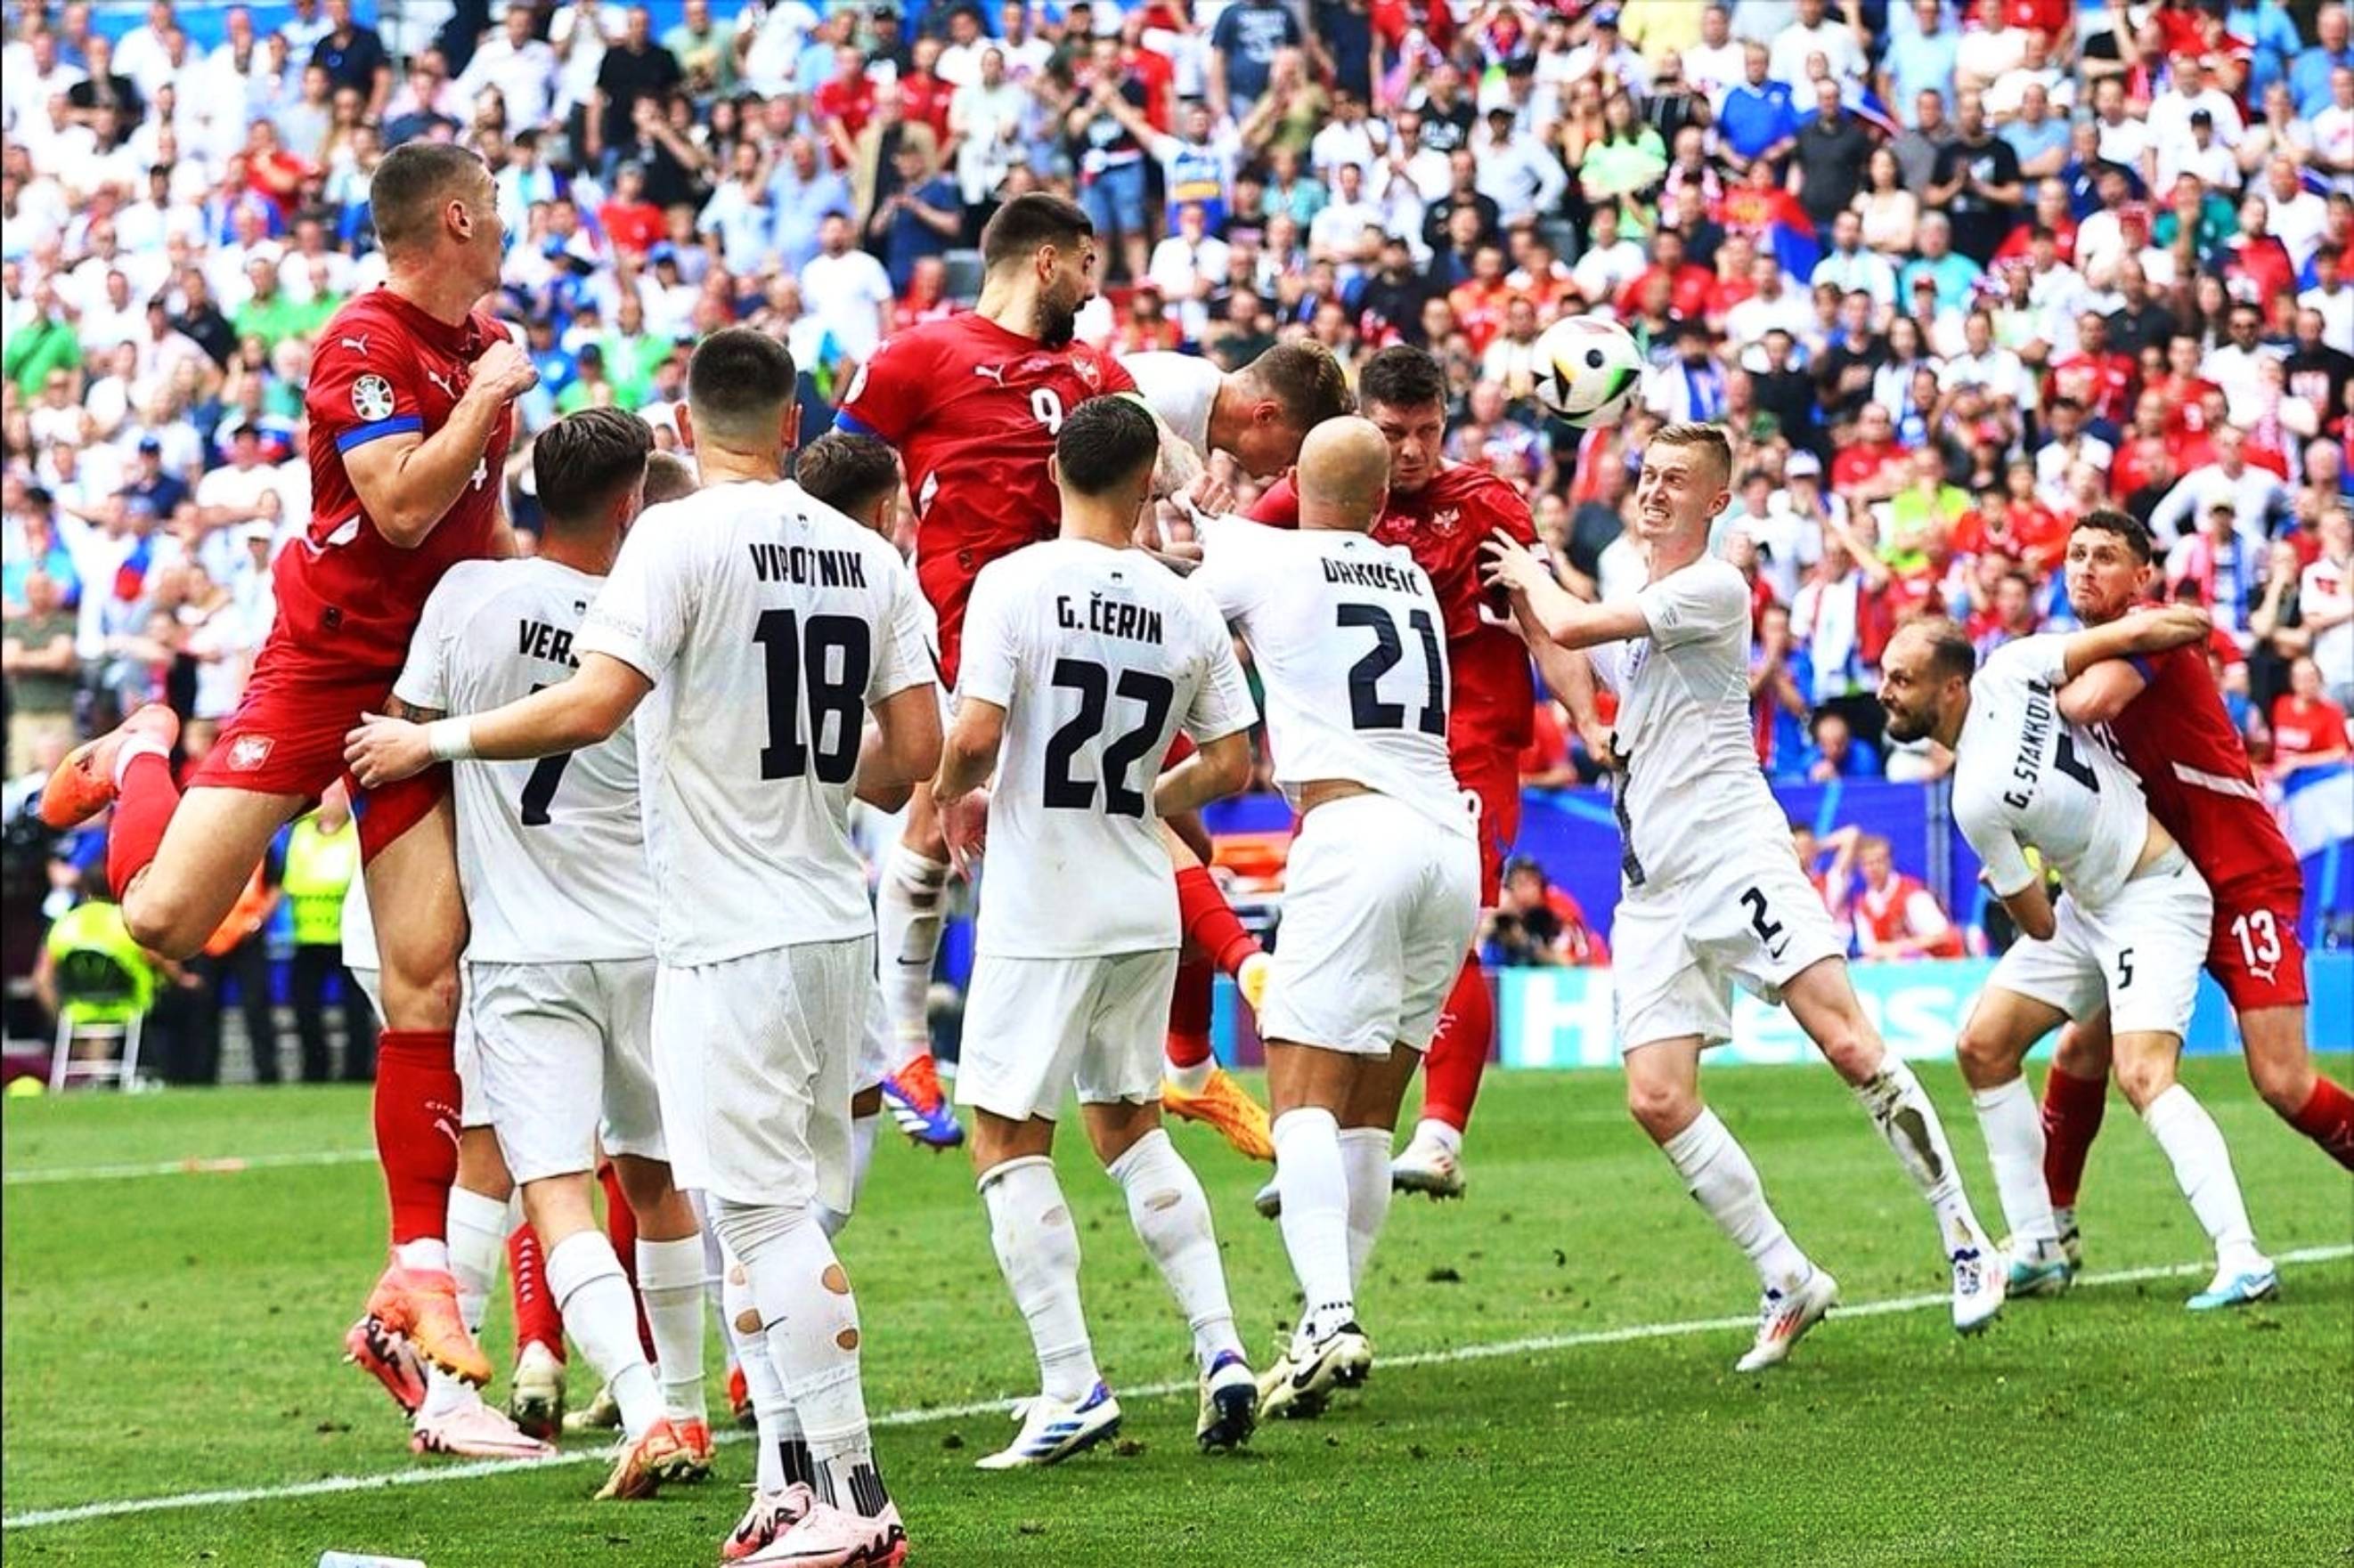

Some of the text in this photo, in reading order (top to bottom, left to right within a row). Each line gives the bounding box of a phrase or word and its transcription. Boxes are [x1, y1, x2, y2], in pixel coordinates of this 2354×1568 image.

[1030, 388, 1063, 435] 9
[519, 620, 580, 668] VER
[1057, 591, 1162, 645] G. ČERIN
[753, 608, 870, 784] 18
[1337, 604, 1446, 737] 21
[1043, 658, 1174, 818] 22
[1740, 887, 1783, 944] 2
[2231, 909, 2281, 966] 13
[2118, 947, 2134, 989] 5
